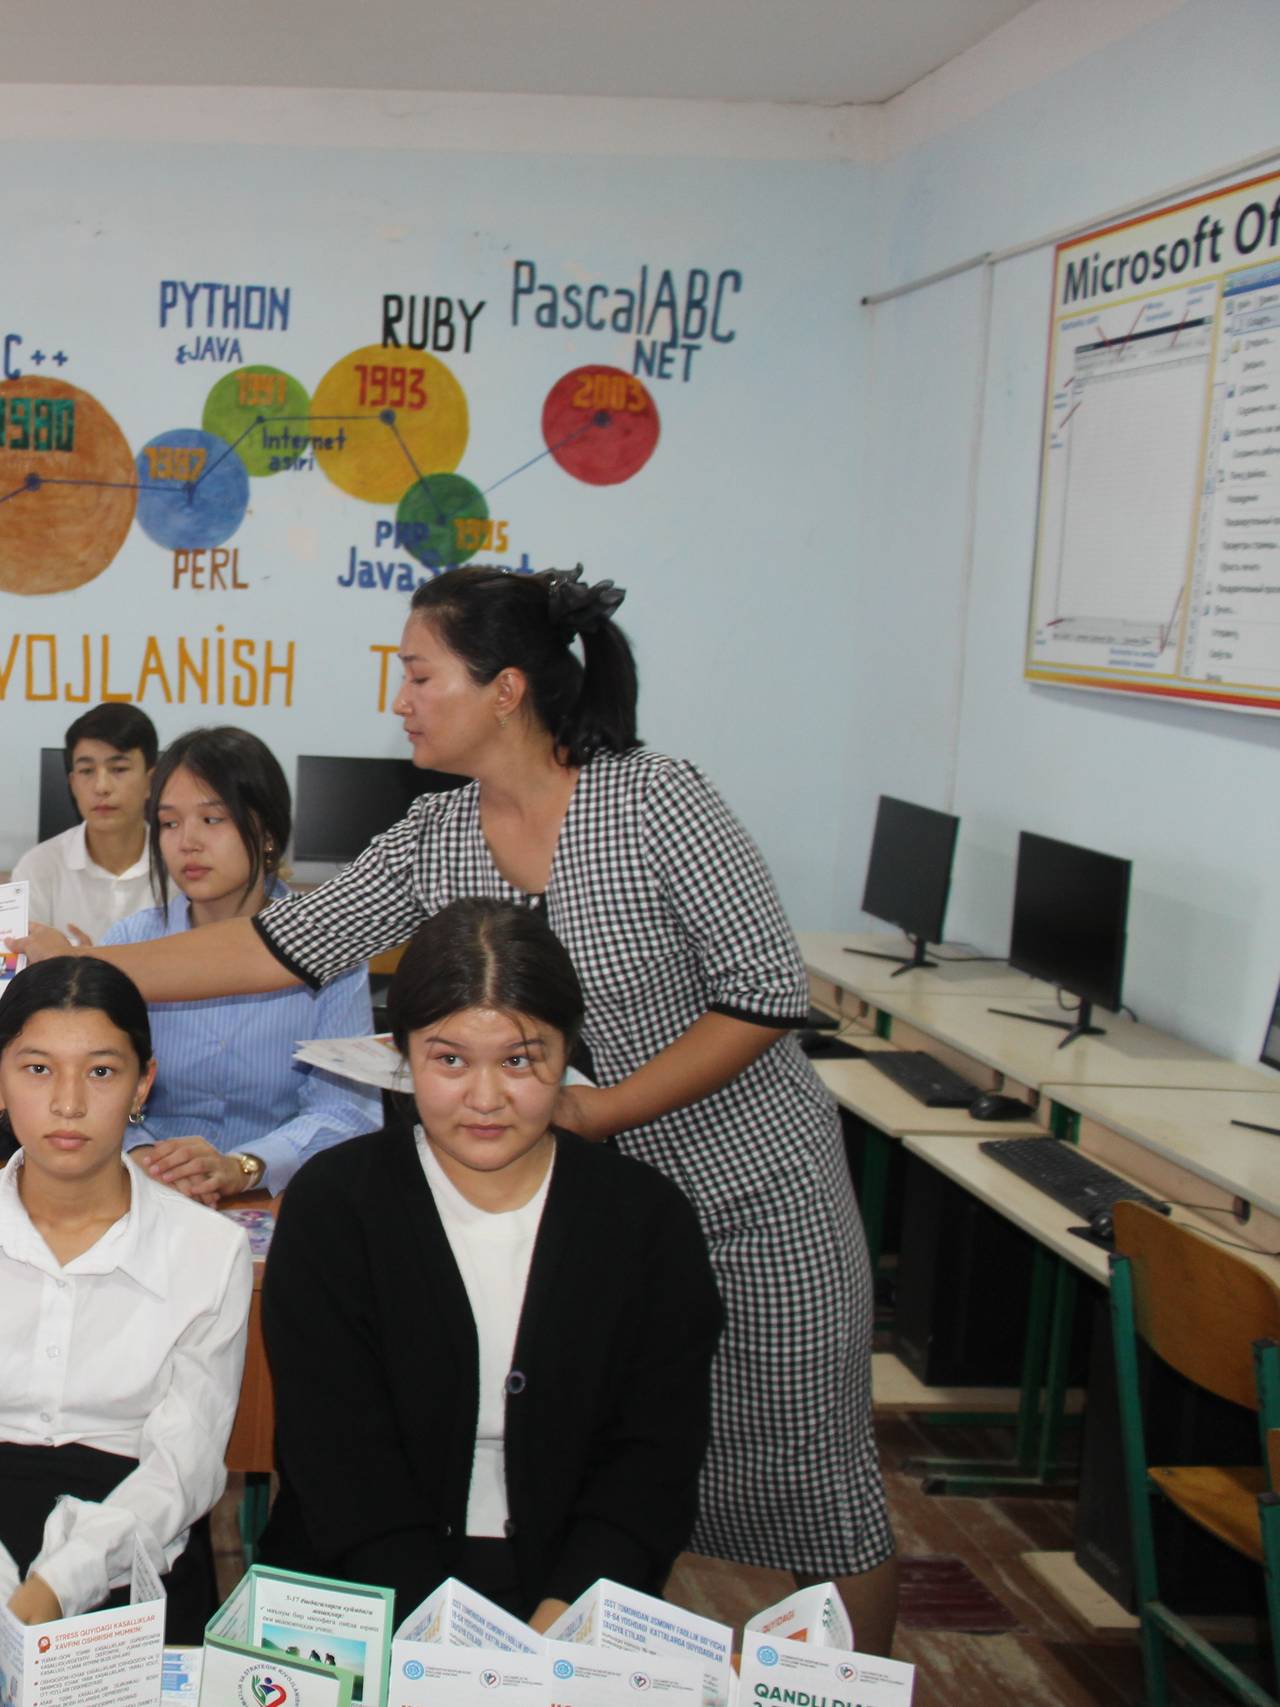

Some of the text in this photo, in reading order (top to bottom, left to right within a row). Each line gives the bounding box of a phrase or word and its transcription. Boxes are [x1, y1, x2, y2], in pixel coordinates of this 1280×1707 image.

[1062, 215, 1223, 304] Microsoft
[159, 281, 290, 331] PYTHON
[381, 294, 486, 353] RUBY
[511, 260, 742, 349] PascalABC
[633, 340, 701, 382] NET
[354, 364, 427, 411] 1993
[572, 373, 648, 413] 2003
[262, 425, 346, 451] Internet
[173, 548, 249, 590] PERL
[754, 1683, 826, 1707] QANDLI
